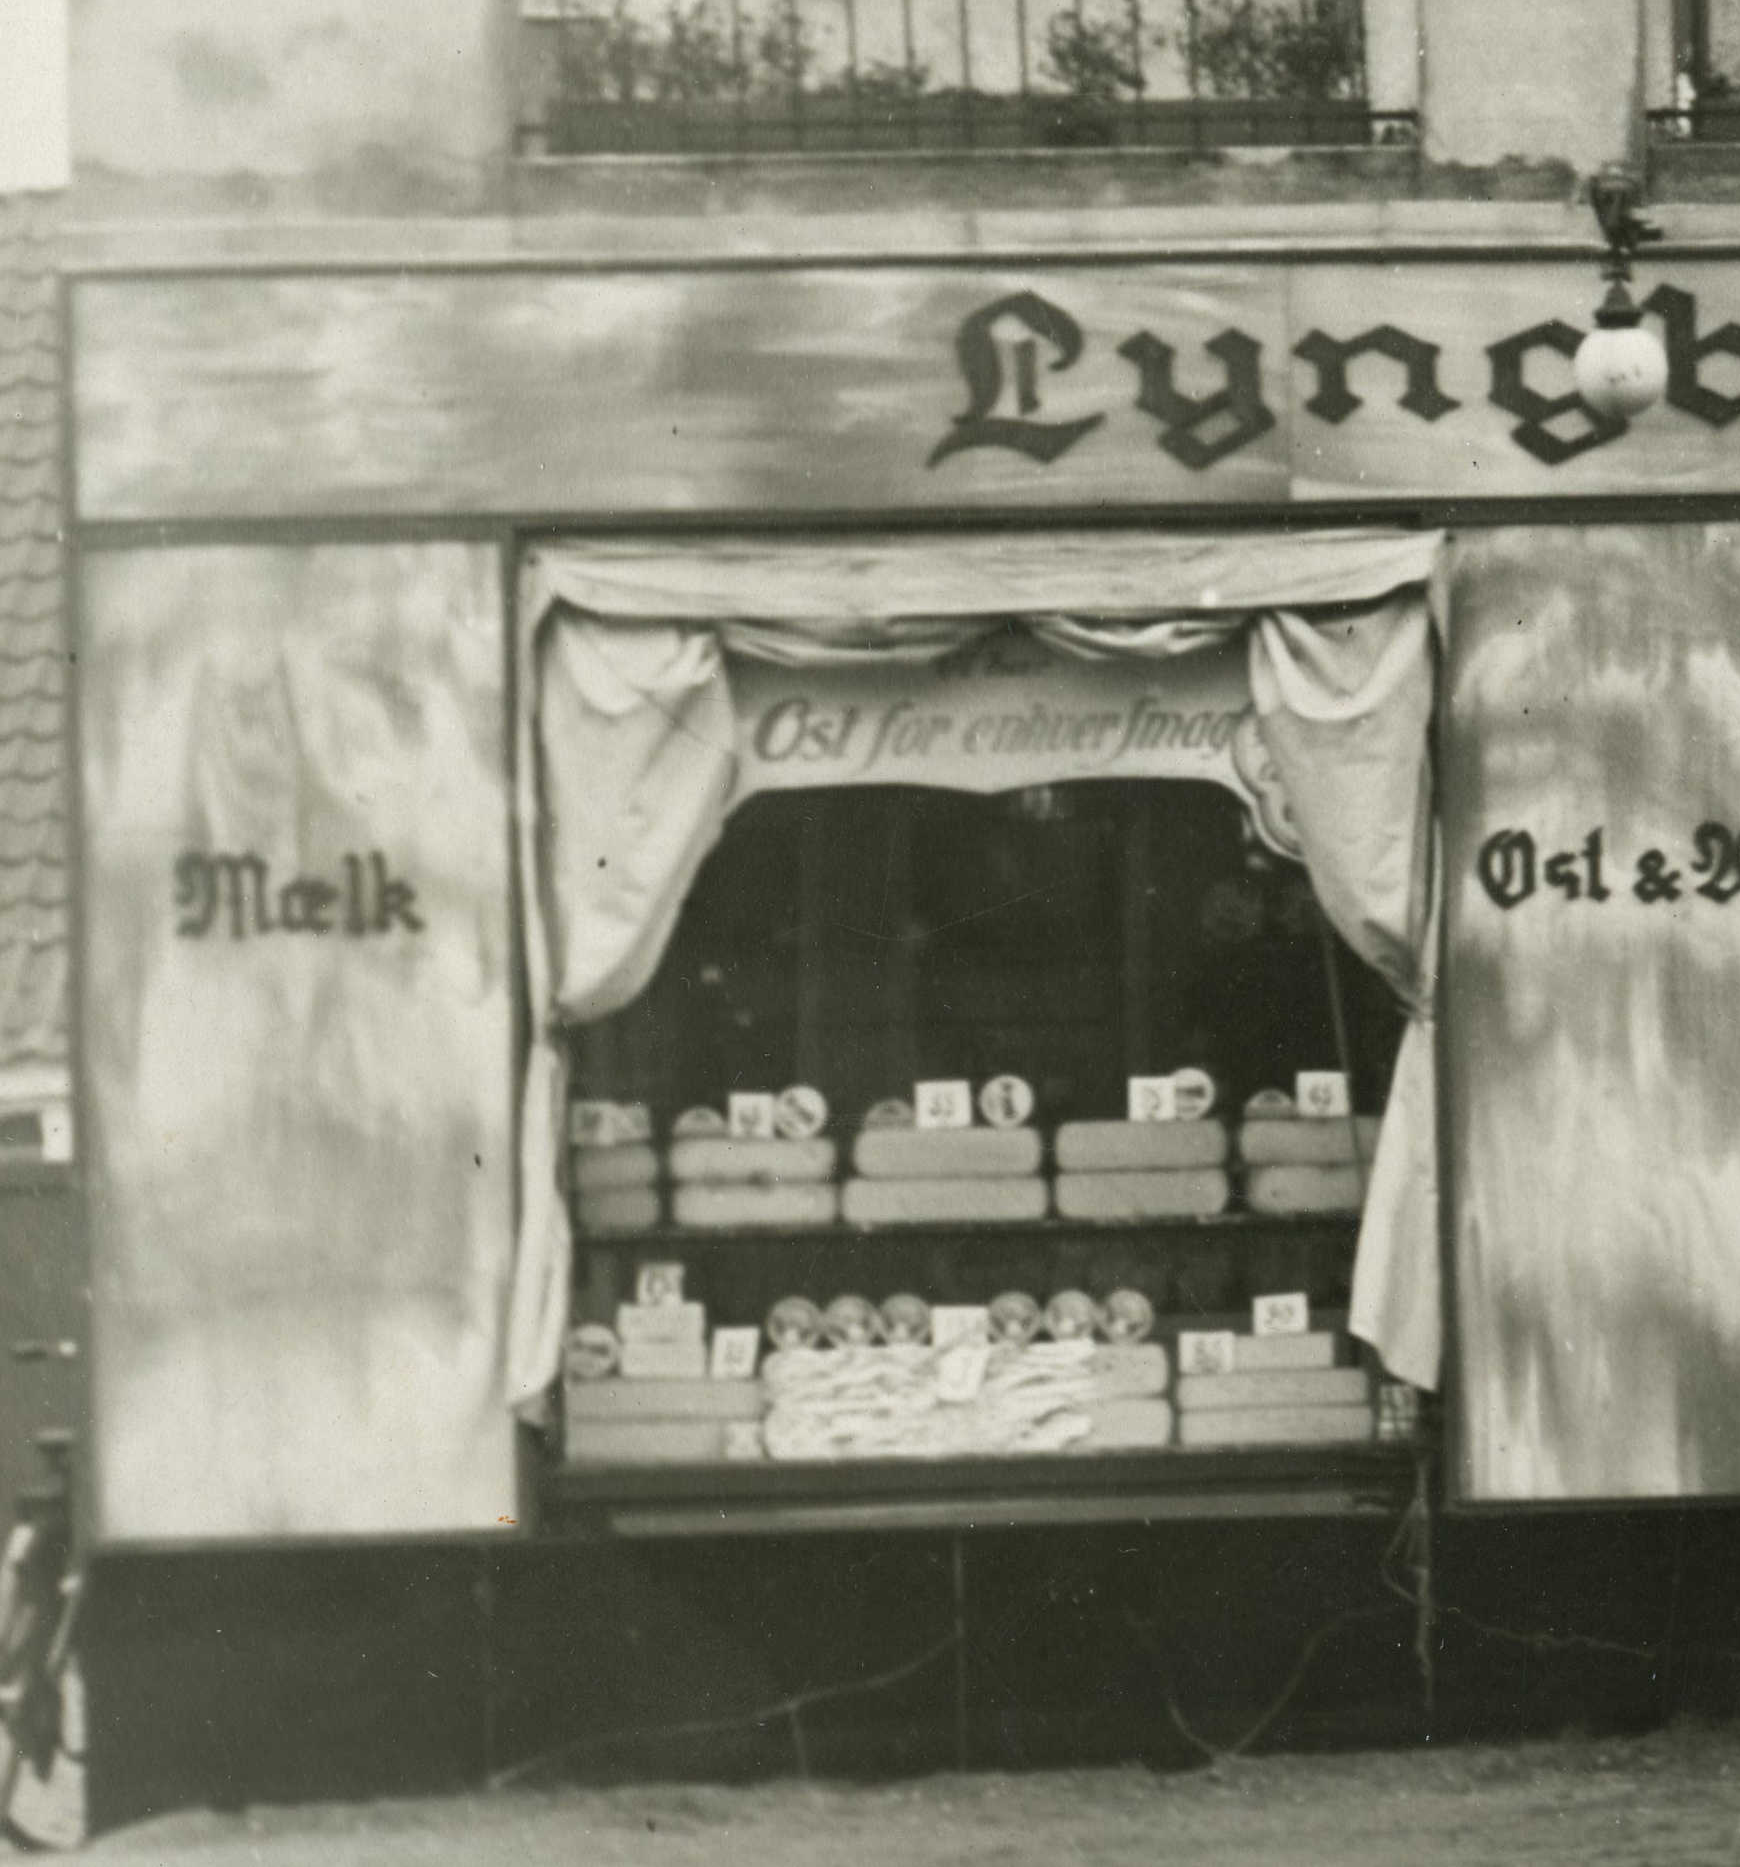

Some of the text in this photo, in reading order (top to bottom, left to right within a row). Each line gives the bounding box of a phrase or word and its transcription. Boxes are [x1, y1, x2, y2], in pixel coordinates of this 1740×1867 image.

[753, 697, 861, 763] Ost
[860, 700, 953, 775] for
[173, 849, 426, 941] Mælk
[1477, 826, 1611, 910] Ost
[1633, 847, 1683, 904] &
